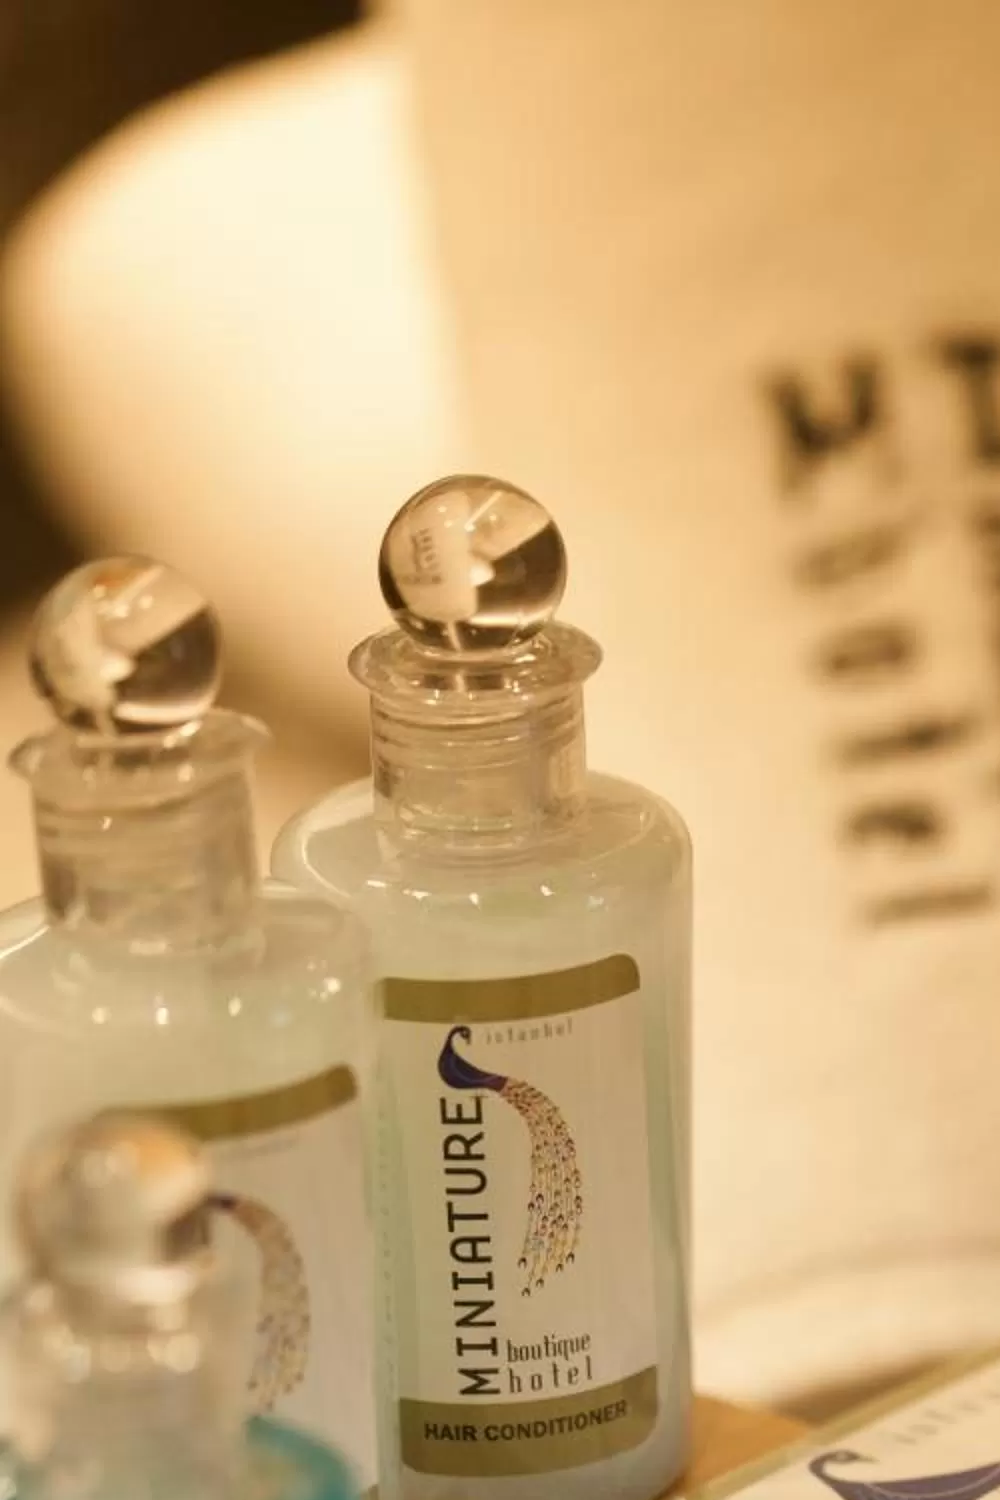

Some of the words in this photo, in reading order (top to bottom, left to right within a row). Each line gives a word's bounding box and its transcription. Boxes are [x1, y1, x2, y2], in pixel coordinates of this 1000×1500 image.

[440, 1096, 501, 1395] MINIATURE
[507, 1333, 591, 1363] boutique
[508, 1355, 593, 1393] hotel
[424, 1422, 478, 1441] HAIR
[484, 1400, 627, 1441] CONDITIONER
